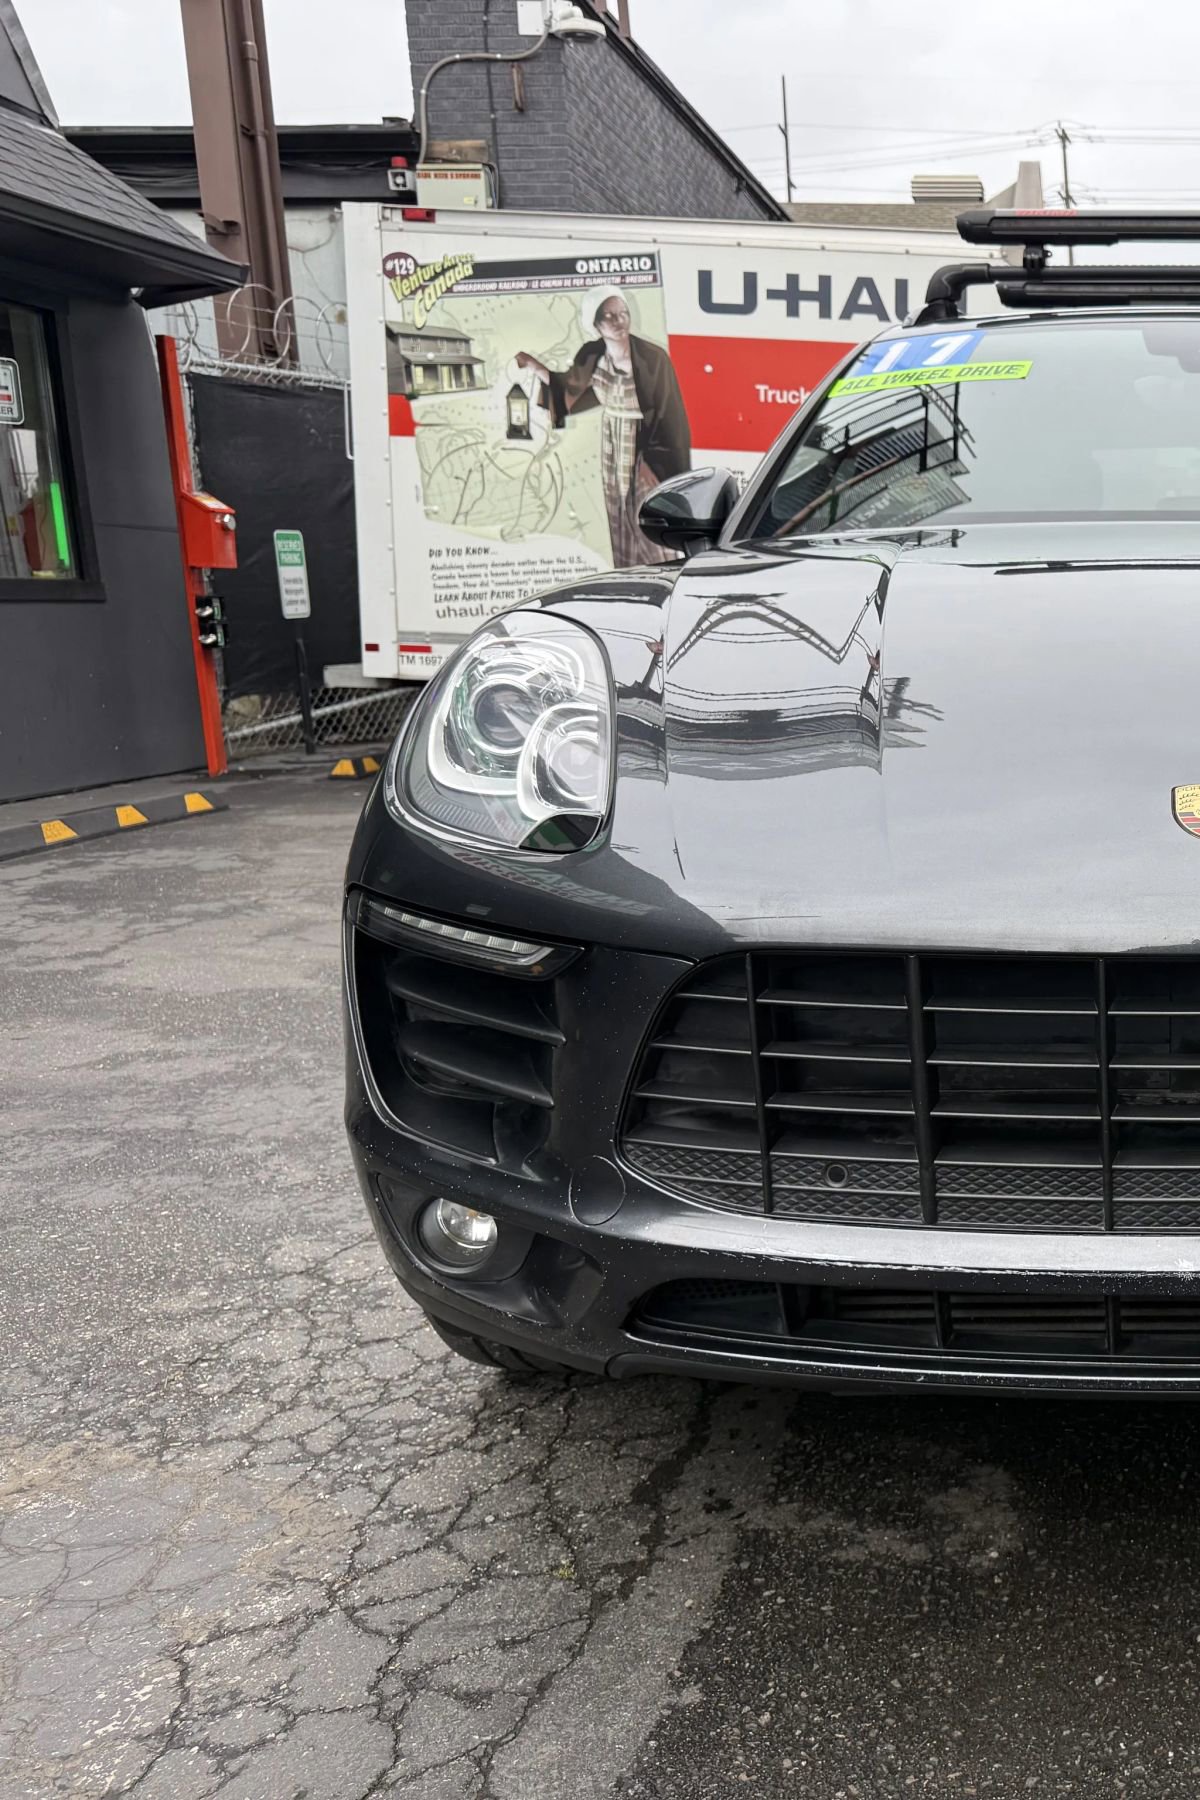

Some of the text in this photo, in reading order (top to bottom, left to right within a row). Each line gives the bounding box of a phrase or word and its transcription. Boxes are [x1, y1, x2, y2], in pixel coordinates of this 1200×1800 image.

[386, 258, 415, 275] #129
[576, 257, 652, 274] ONTARIO
[390, 262, 443, 303] Venture
[414, 262, 474, 330] Canada
[698, 270, 967, 322] U-HA
[873, 334, 974, 373] 17
[839, 363, 1026, 393] ALL WHEEL DRIVE
[429, 548, 442, 558] DID
[446, 547, 463, 557] YOU
[434, 592, 459, 603] LEARN
[461, 590, 487, 601] ABOUT
[490, 589, 515, 600] PATHS
[400, 654, 416, 665] TM
